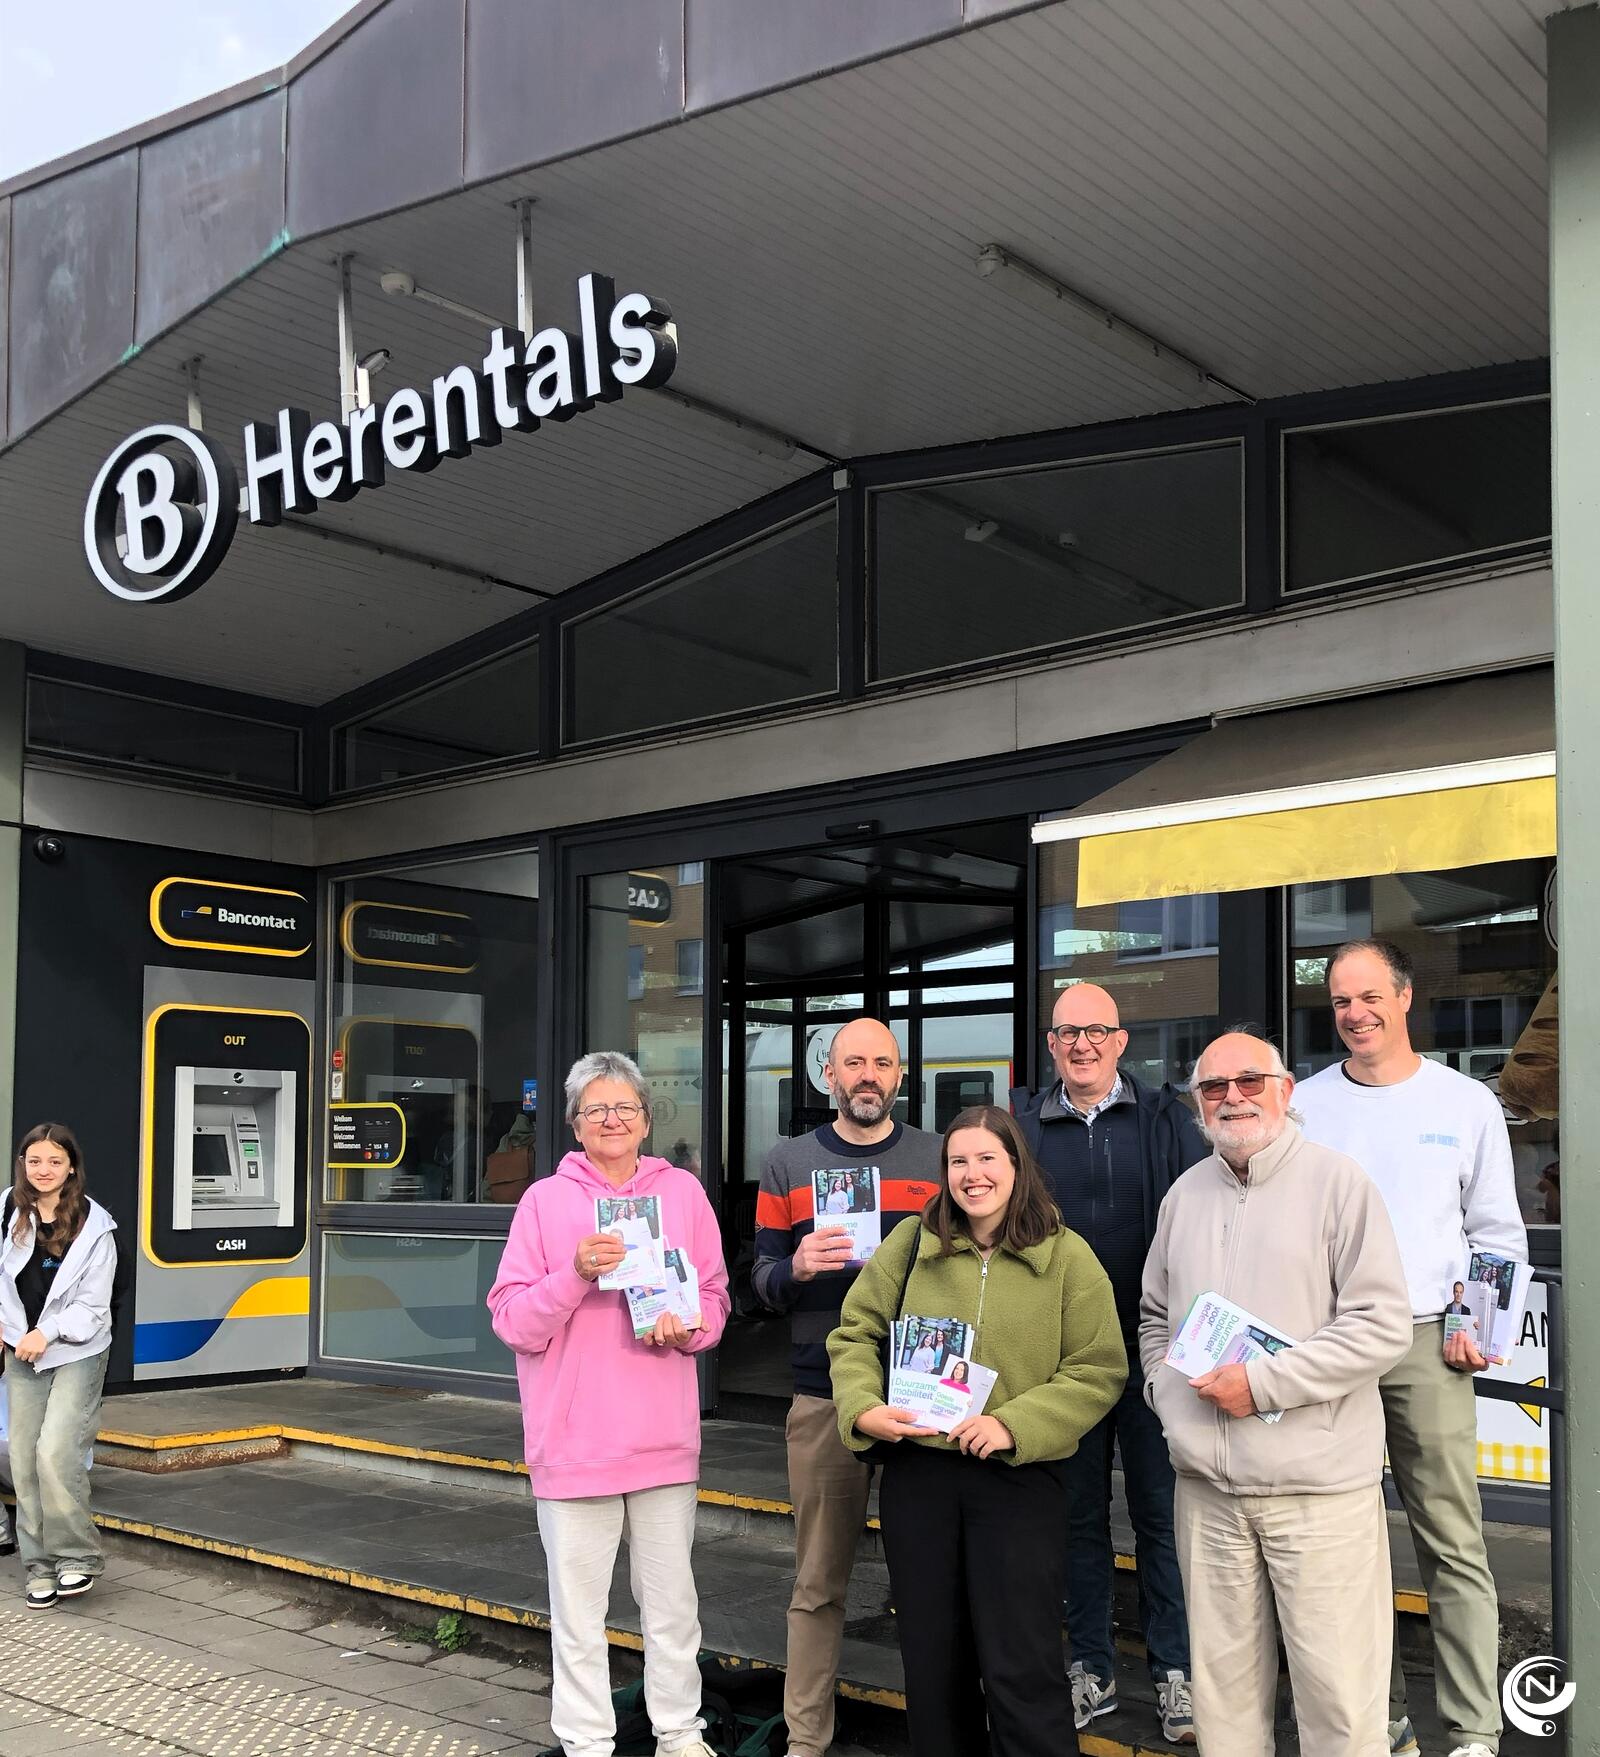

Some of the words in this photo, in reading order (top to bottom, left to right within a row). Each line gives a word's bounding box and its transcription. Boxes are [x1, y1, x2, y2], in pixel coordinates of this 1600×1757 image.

[244, 272, 664, 525] Herentals
[217, 907, 296, 931] Bancontact
[223, 1034, 247, 1046] OUT
[215, 1238, 247, 1251] CASH
[1190, 1301, 1213, 1342] iedereen
[1207, 1303, 1222, 1328] voor
[1203, 1310, 1230, 1354] mobiliteit
[1211, 1314, 1241, 1361] Duurzame
[893, 1387, 933, 1401] mobiliteit
[895, 1377, 938, 1392] Duurzame
[892, 1396, 911, 1405] voor
